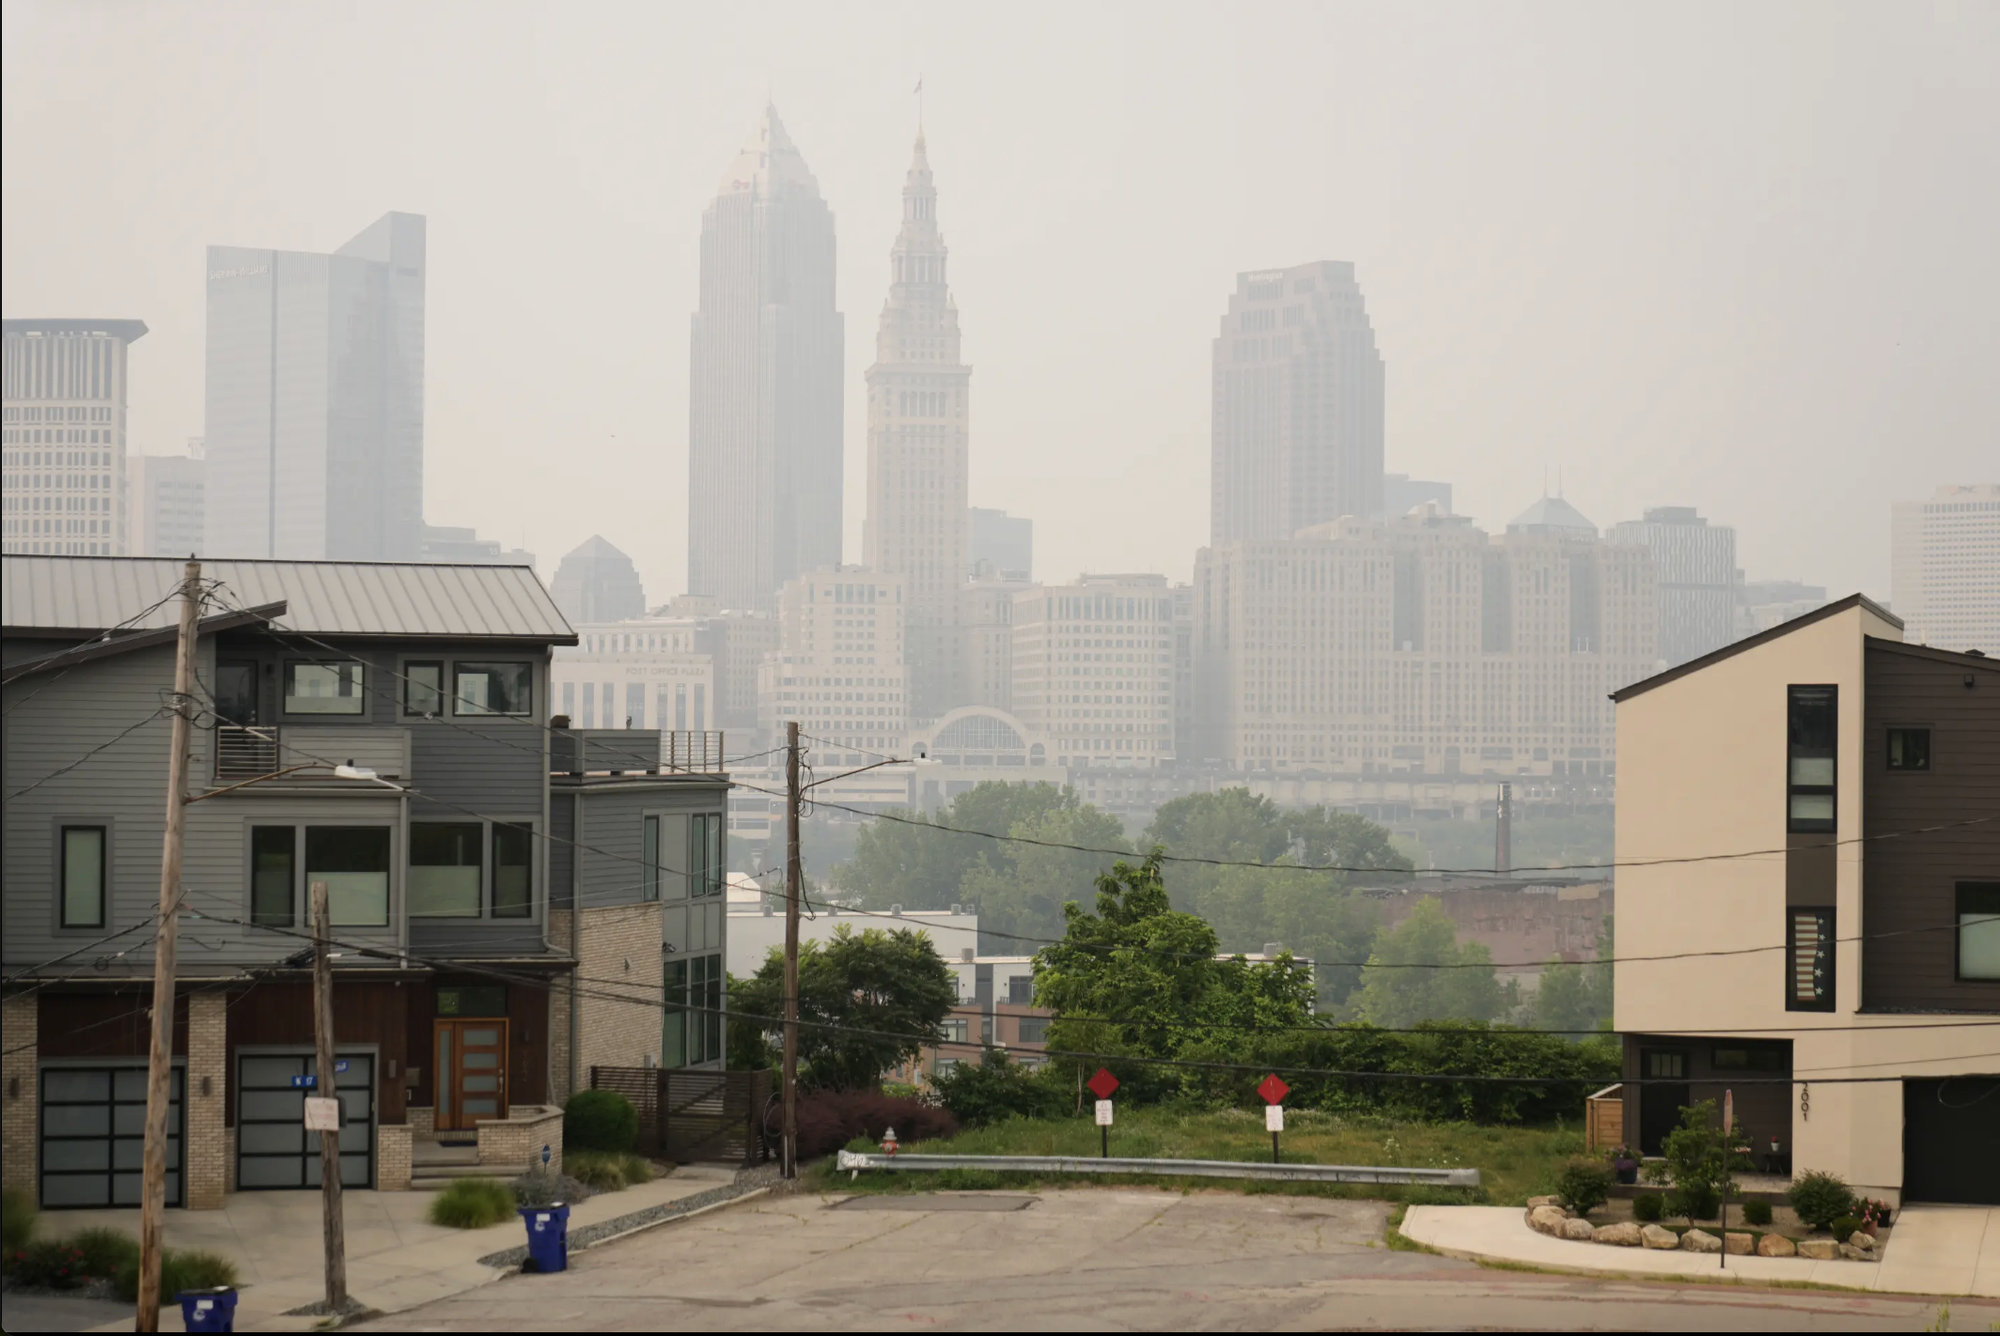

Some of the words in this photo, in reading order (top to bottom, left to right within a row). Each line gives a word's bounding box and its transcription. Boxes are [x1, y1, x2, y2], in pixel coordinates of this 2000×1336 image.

[626, 666, 648, 676] POST
[650, 667, 679, 676] OFFICE
[681, 667, 706, 677] PLAZA
[1800, 1081, 1810, 1122] 2001
